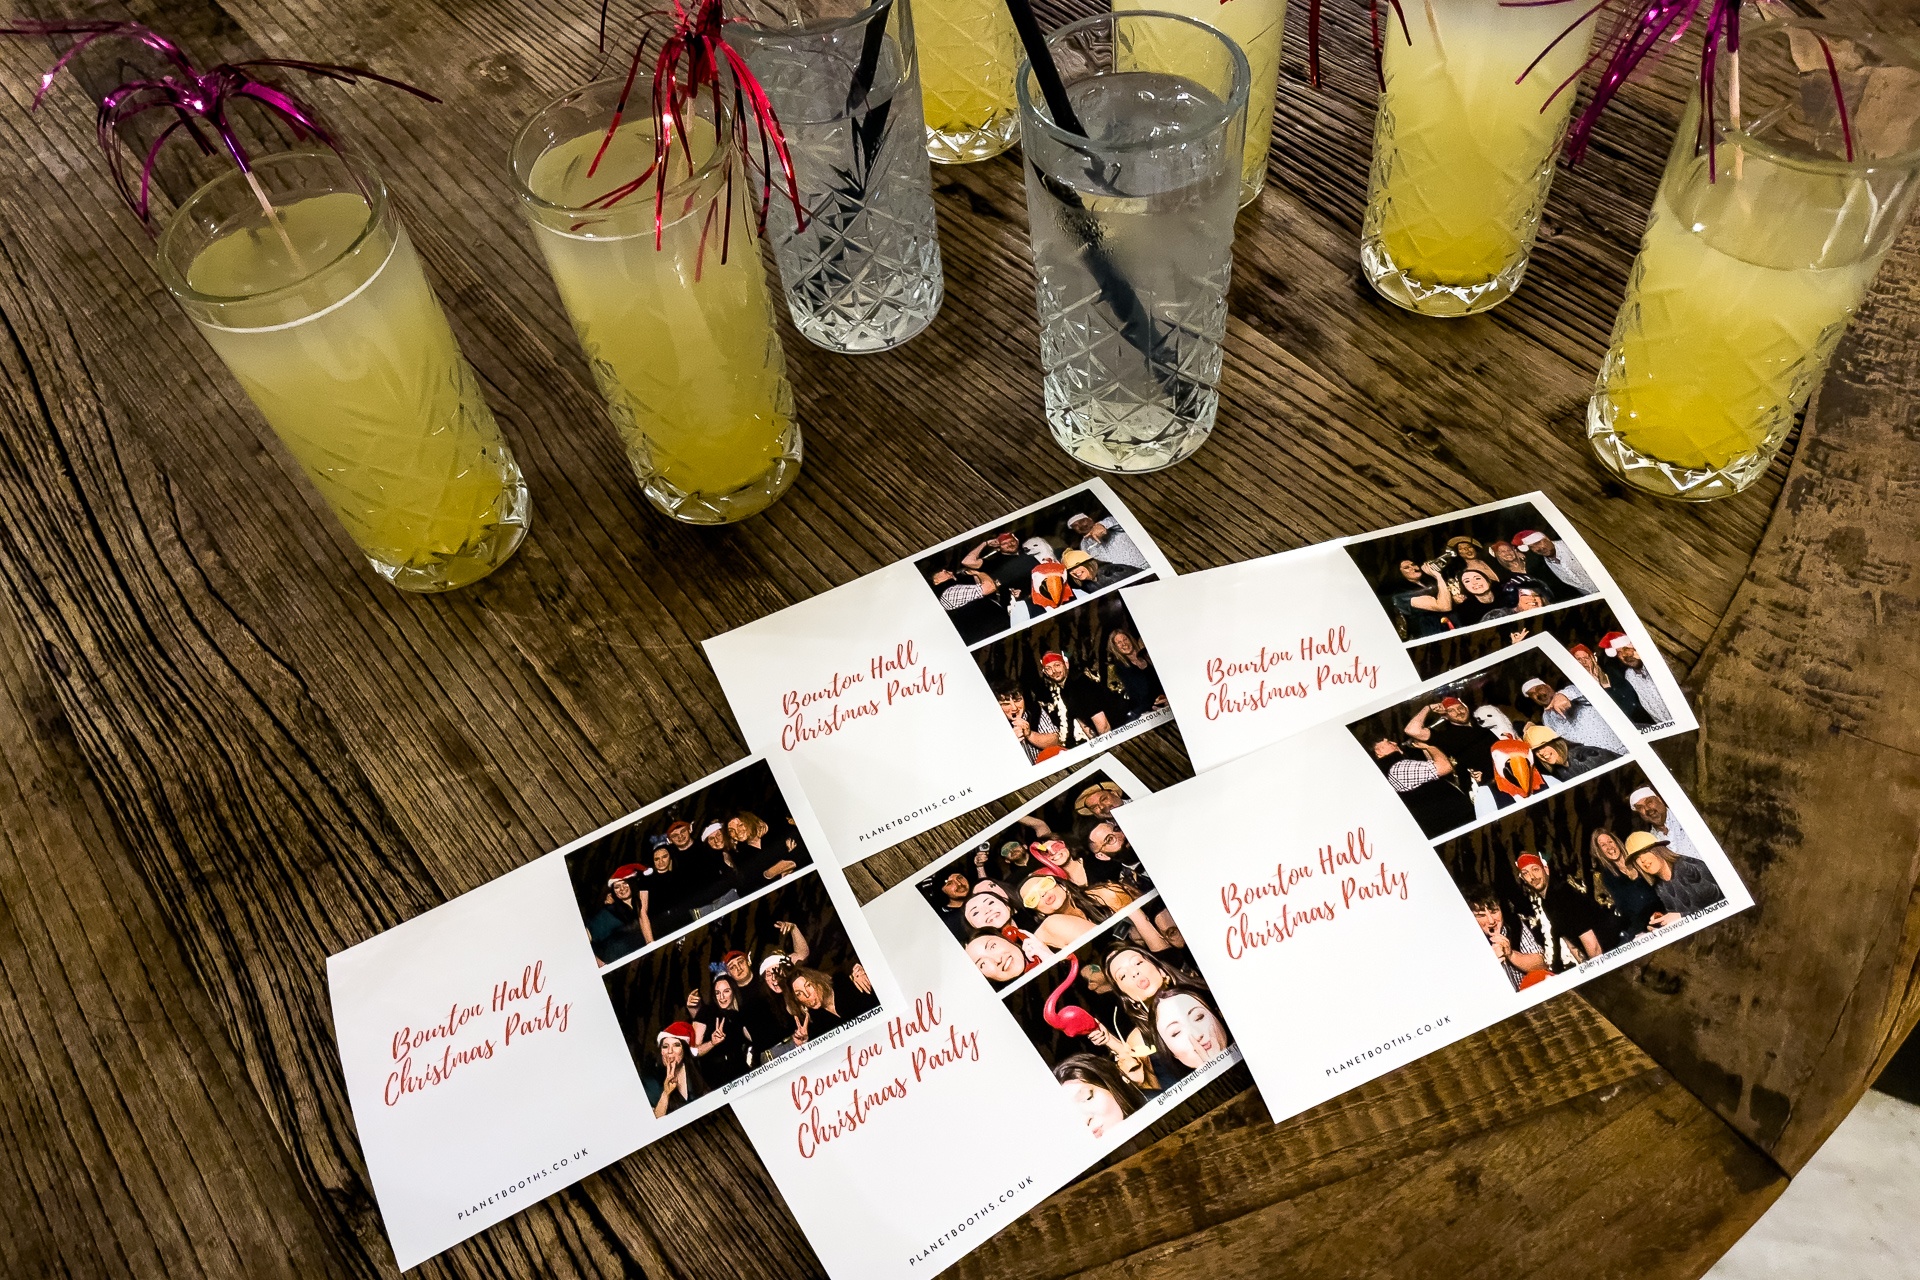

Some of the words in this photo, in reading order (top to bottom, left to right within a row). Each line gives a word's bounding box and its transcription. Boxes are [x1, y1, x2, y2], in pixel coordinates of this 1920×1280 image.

[782, 672, 864, 718] Bourton
[871, 639, 918, 679] Hall
[1205, 680, 1309, 721] Christmas
[1316, 656, 1380, 691] Party
[1207, 647, 1293, 686] Bourton
[1301, 625, 1351, 661] Hall
[781, 700, 880, 751] Christmas
[887, 666, 946, 706] Party
[859, 787, 973, 842] PLANETBOOTHS.CO.UK
[1221, 863, 1313, 918] Bourton
[1319, 827, 1373, 874] Hall
[1226, 901, 1336, 960] Christmas
[1342, 862, 1409, 910] Party
[1658, 917, 1690, 938] password
[384, 1039, 497, 1107] Christmas
[505, 995, 573, 1046] Party
[392, 1003, 484, 1064] Bourton
[492, 960, 546, 1012] Hall
[791, 1045, 883, 1114] Bourton
[887, 991, 942, 1049] Hall
[808, 1027, 841, 1051] password
[1325, 1015, 1451, 1077] PLANETBOOTHS.CO.UK
[798, 1077, 908, 1159] Christmas
[911, 1025, 980, 1082] Party
[457, 1148, 589, 1220] PLANETBOOTHS.CO.UK
[909, 1175, 1033, 1266] PLANETBOOTHS.CO.UK
